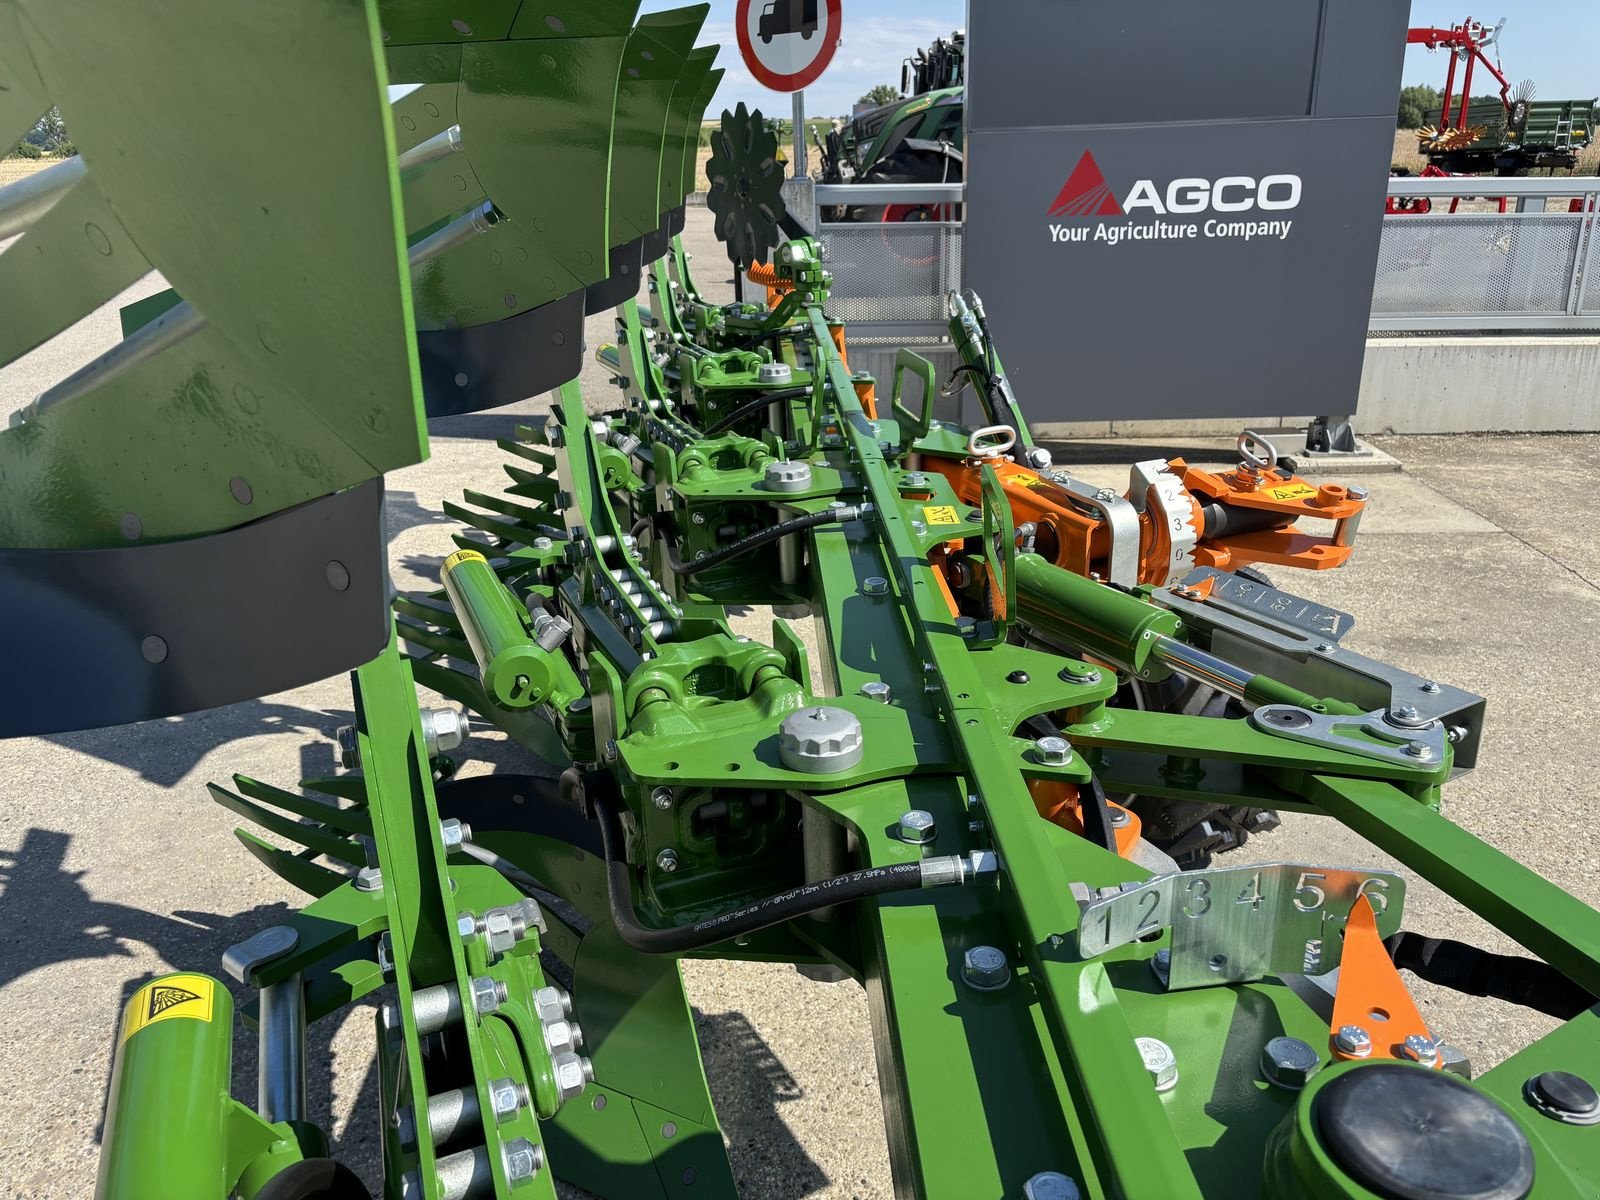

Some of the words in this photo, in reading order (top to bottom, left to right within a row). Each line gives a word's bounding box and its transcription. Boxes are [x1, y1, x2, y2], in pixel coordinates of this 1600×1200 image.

[1122, 174, 1302, 215] AGCO
[1048, 224, 1090, 242] Your
[1094, 220, 1197, 245] Agriculture
[1204, 219, 1292, 241] Company
[1174, 517, 1182, 531] 3
[1097, 905, 1112, 948] 1
[1135, 889, 1160, 937] 2
[1183, 878, 1211, 919] 3
[1235, 872, 1265, 911] 4
[1293, 872, 1326, 913] 5
